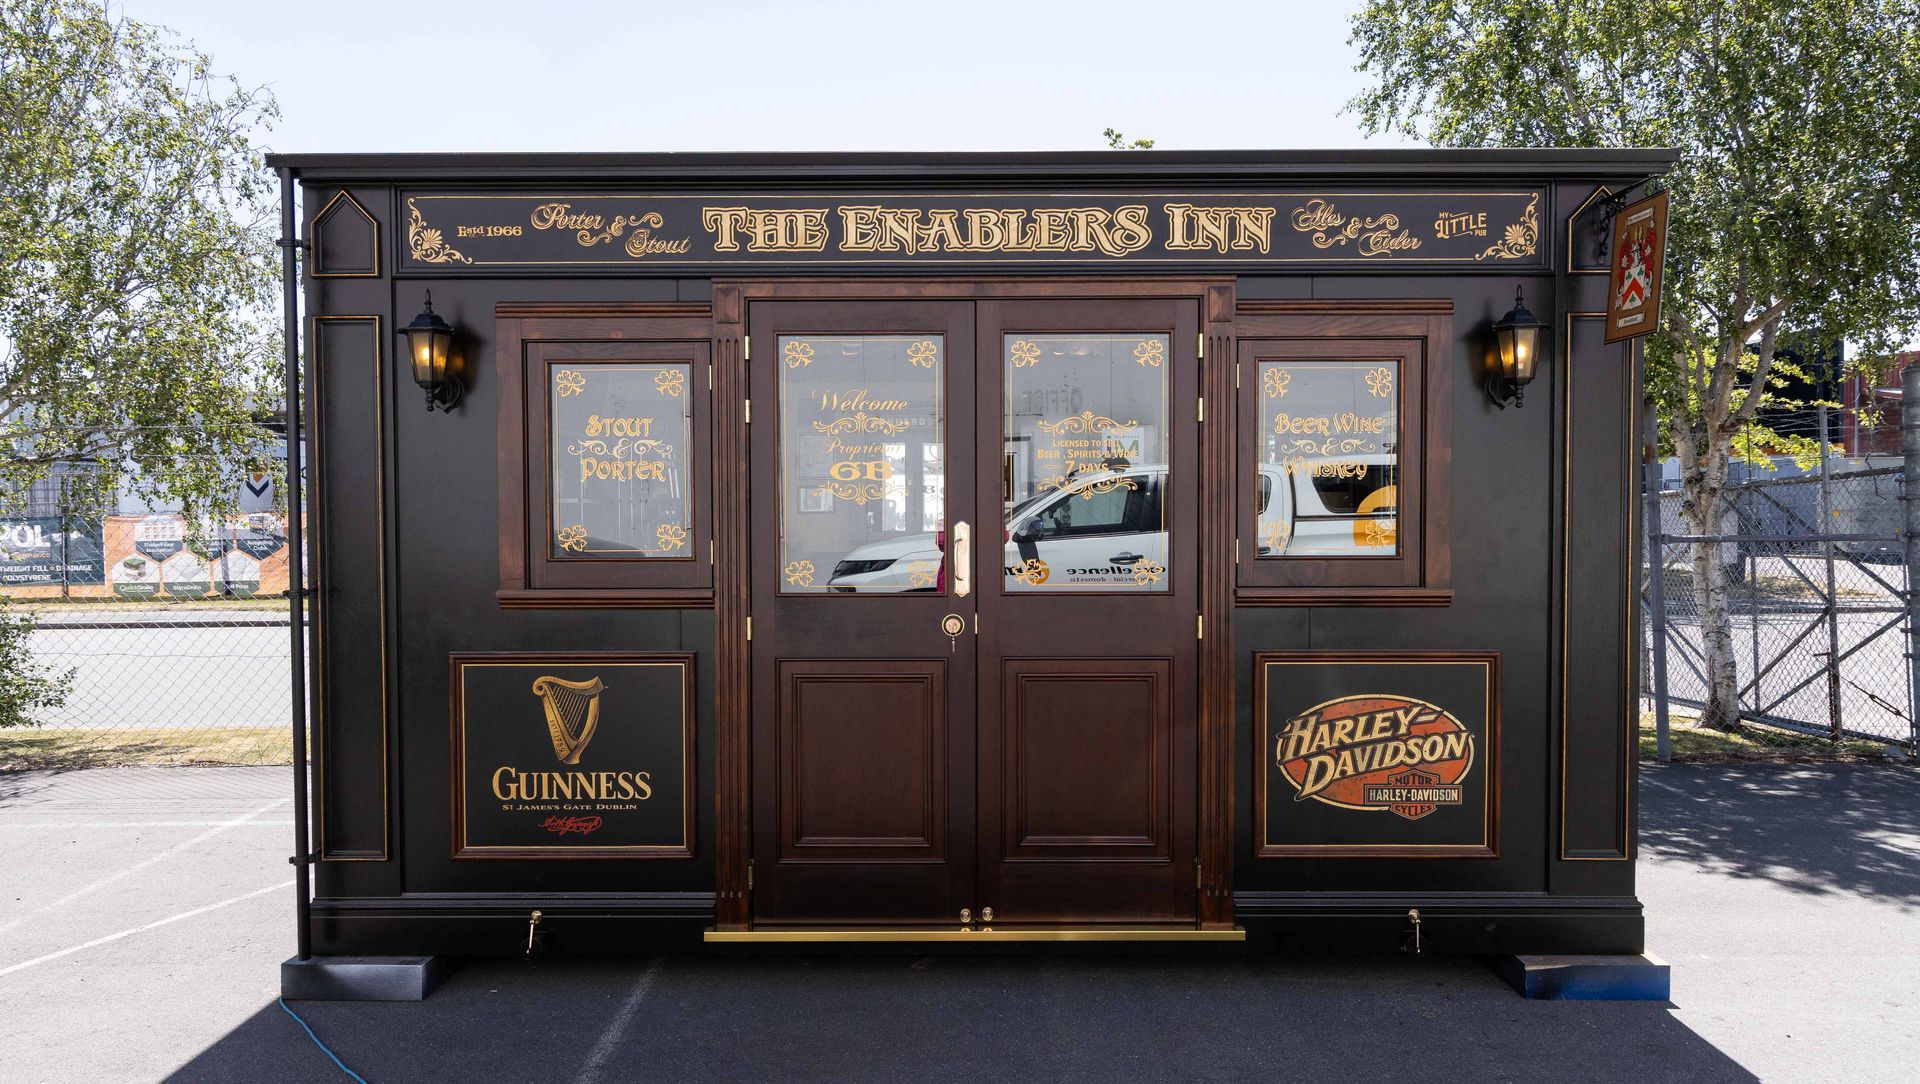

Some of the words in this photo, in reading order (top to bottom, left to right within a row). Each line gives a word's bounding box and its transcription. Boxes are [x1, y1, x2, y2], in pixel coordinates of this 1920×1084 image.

[531, 203, 605, 229] Porter
[1291, 198, 1346, 231] Ales
[487, 226, 522, 236] 1966
[607, 215, 627, 236] &
[702, 206, 829, 252] THE
[838, 204, 1152, 256] ENABLERS
[1163, 203, 1277, 255] INN
[1342, 217, 1362, 238] &
[1435, 212, 1487, 239] LITTLE
[1475, 229, 1487, 237] PUB
[625, 228, 692, 257] Stout
[1358, 229, 1422, 256] Cider
[812, 389, 909, 412] Welcome
[611, 438, 632, 458] &
[1053, 439, 1089, 447] LICENSED
[1321, 438, 1338, 456] &
[1067, 449, 1102, 458] SPIRITS
[830, 461, 894, 480] 6B
[1065, 460, 1075, 474] 7
[1079, 462, 1109, 473] DAYS
[1296, 731, 1470, 799] DAVIDSON
[492, 766, 652, 800] GUINNESS
[1395, 773, 1432, 784] MOTOR
[1369, 789, 1458, 801] HARLEY-DAVIDSON
[1395, 805, 1432, 817] CYCLES
